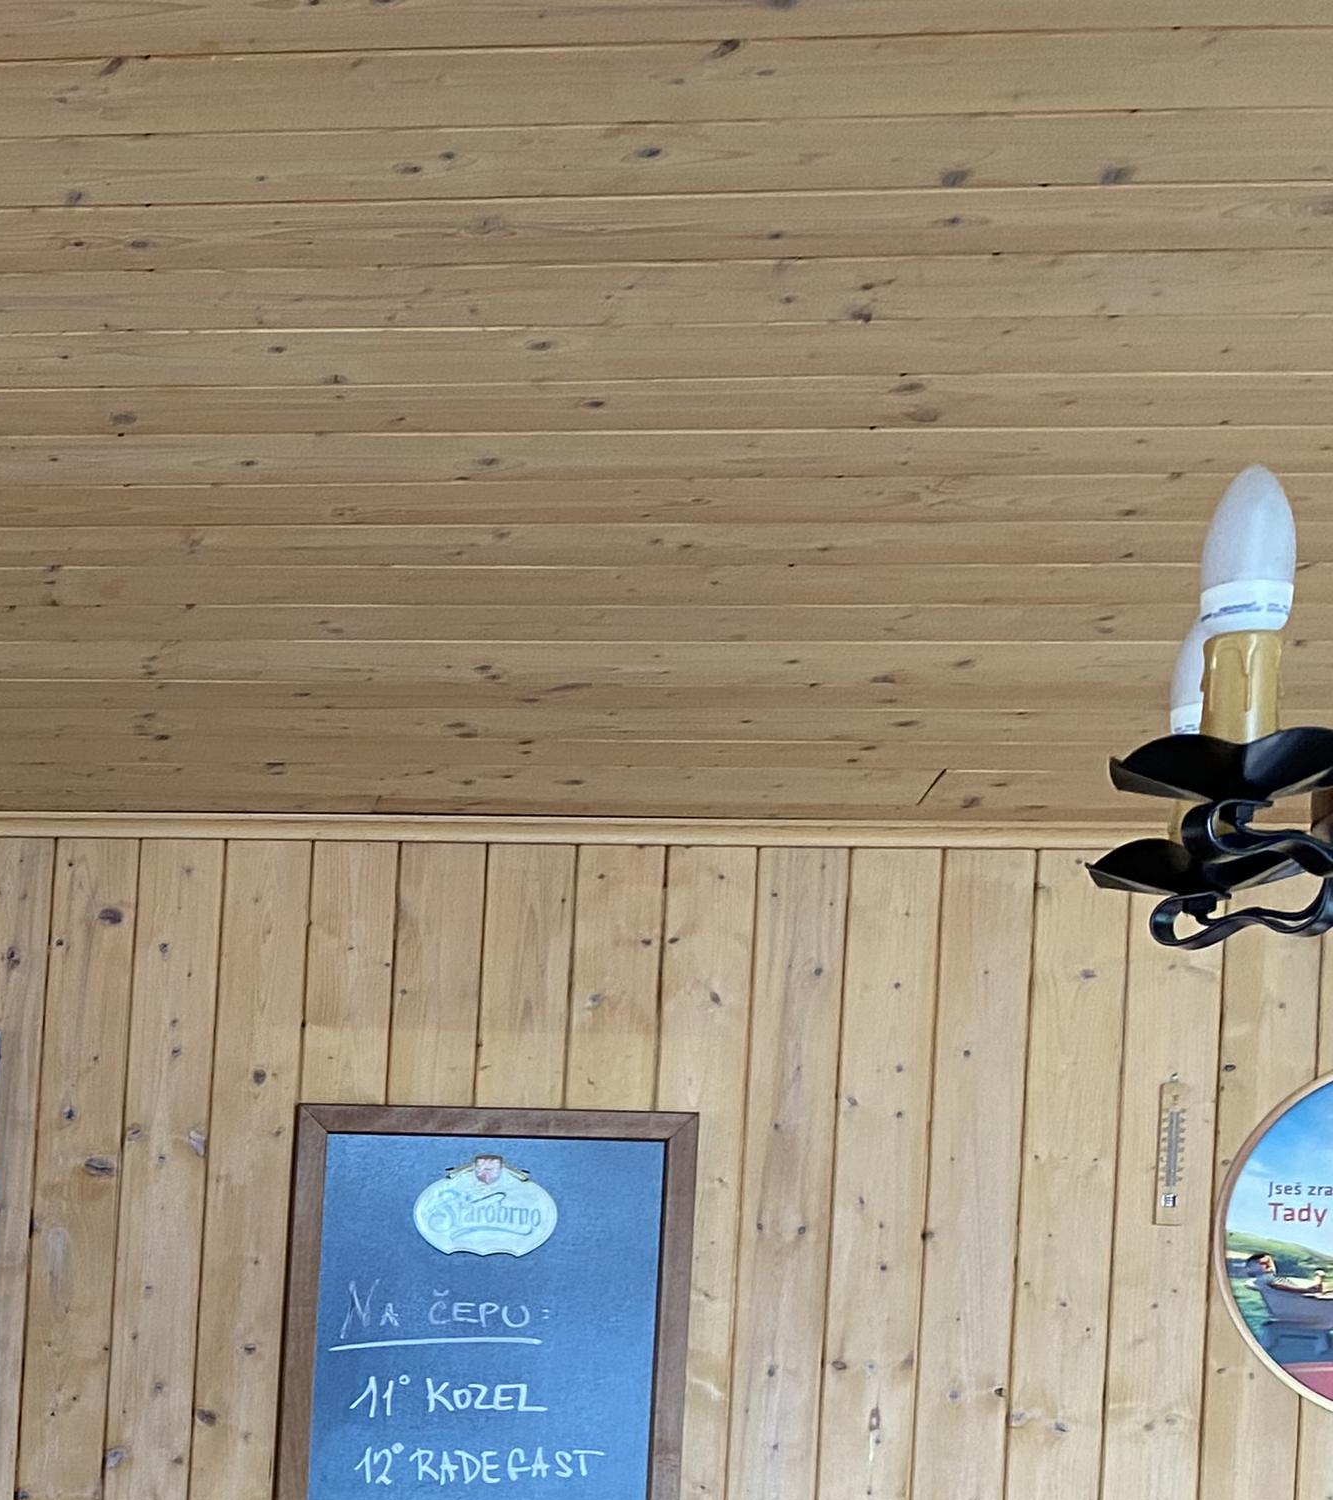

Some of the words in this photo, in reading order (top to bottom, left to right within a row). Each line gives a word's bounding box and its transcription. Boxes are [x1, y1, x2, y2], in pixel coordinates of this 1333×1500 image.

[1267, 1181, 1303, 1198] Jseš
[427, 1189, 542, 1233] Starobrno
[1267, 1202, 1328, 1228] Tady
[427, 1377, 549, 1414] KOZEL
[409, 1446, 606, 1486] RADEGAST
